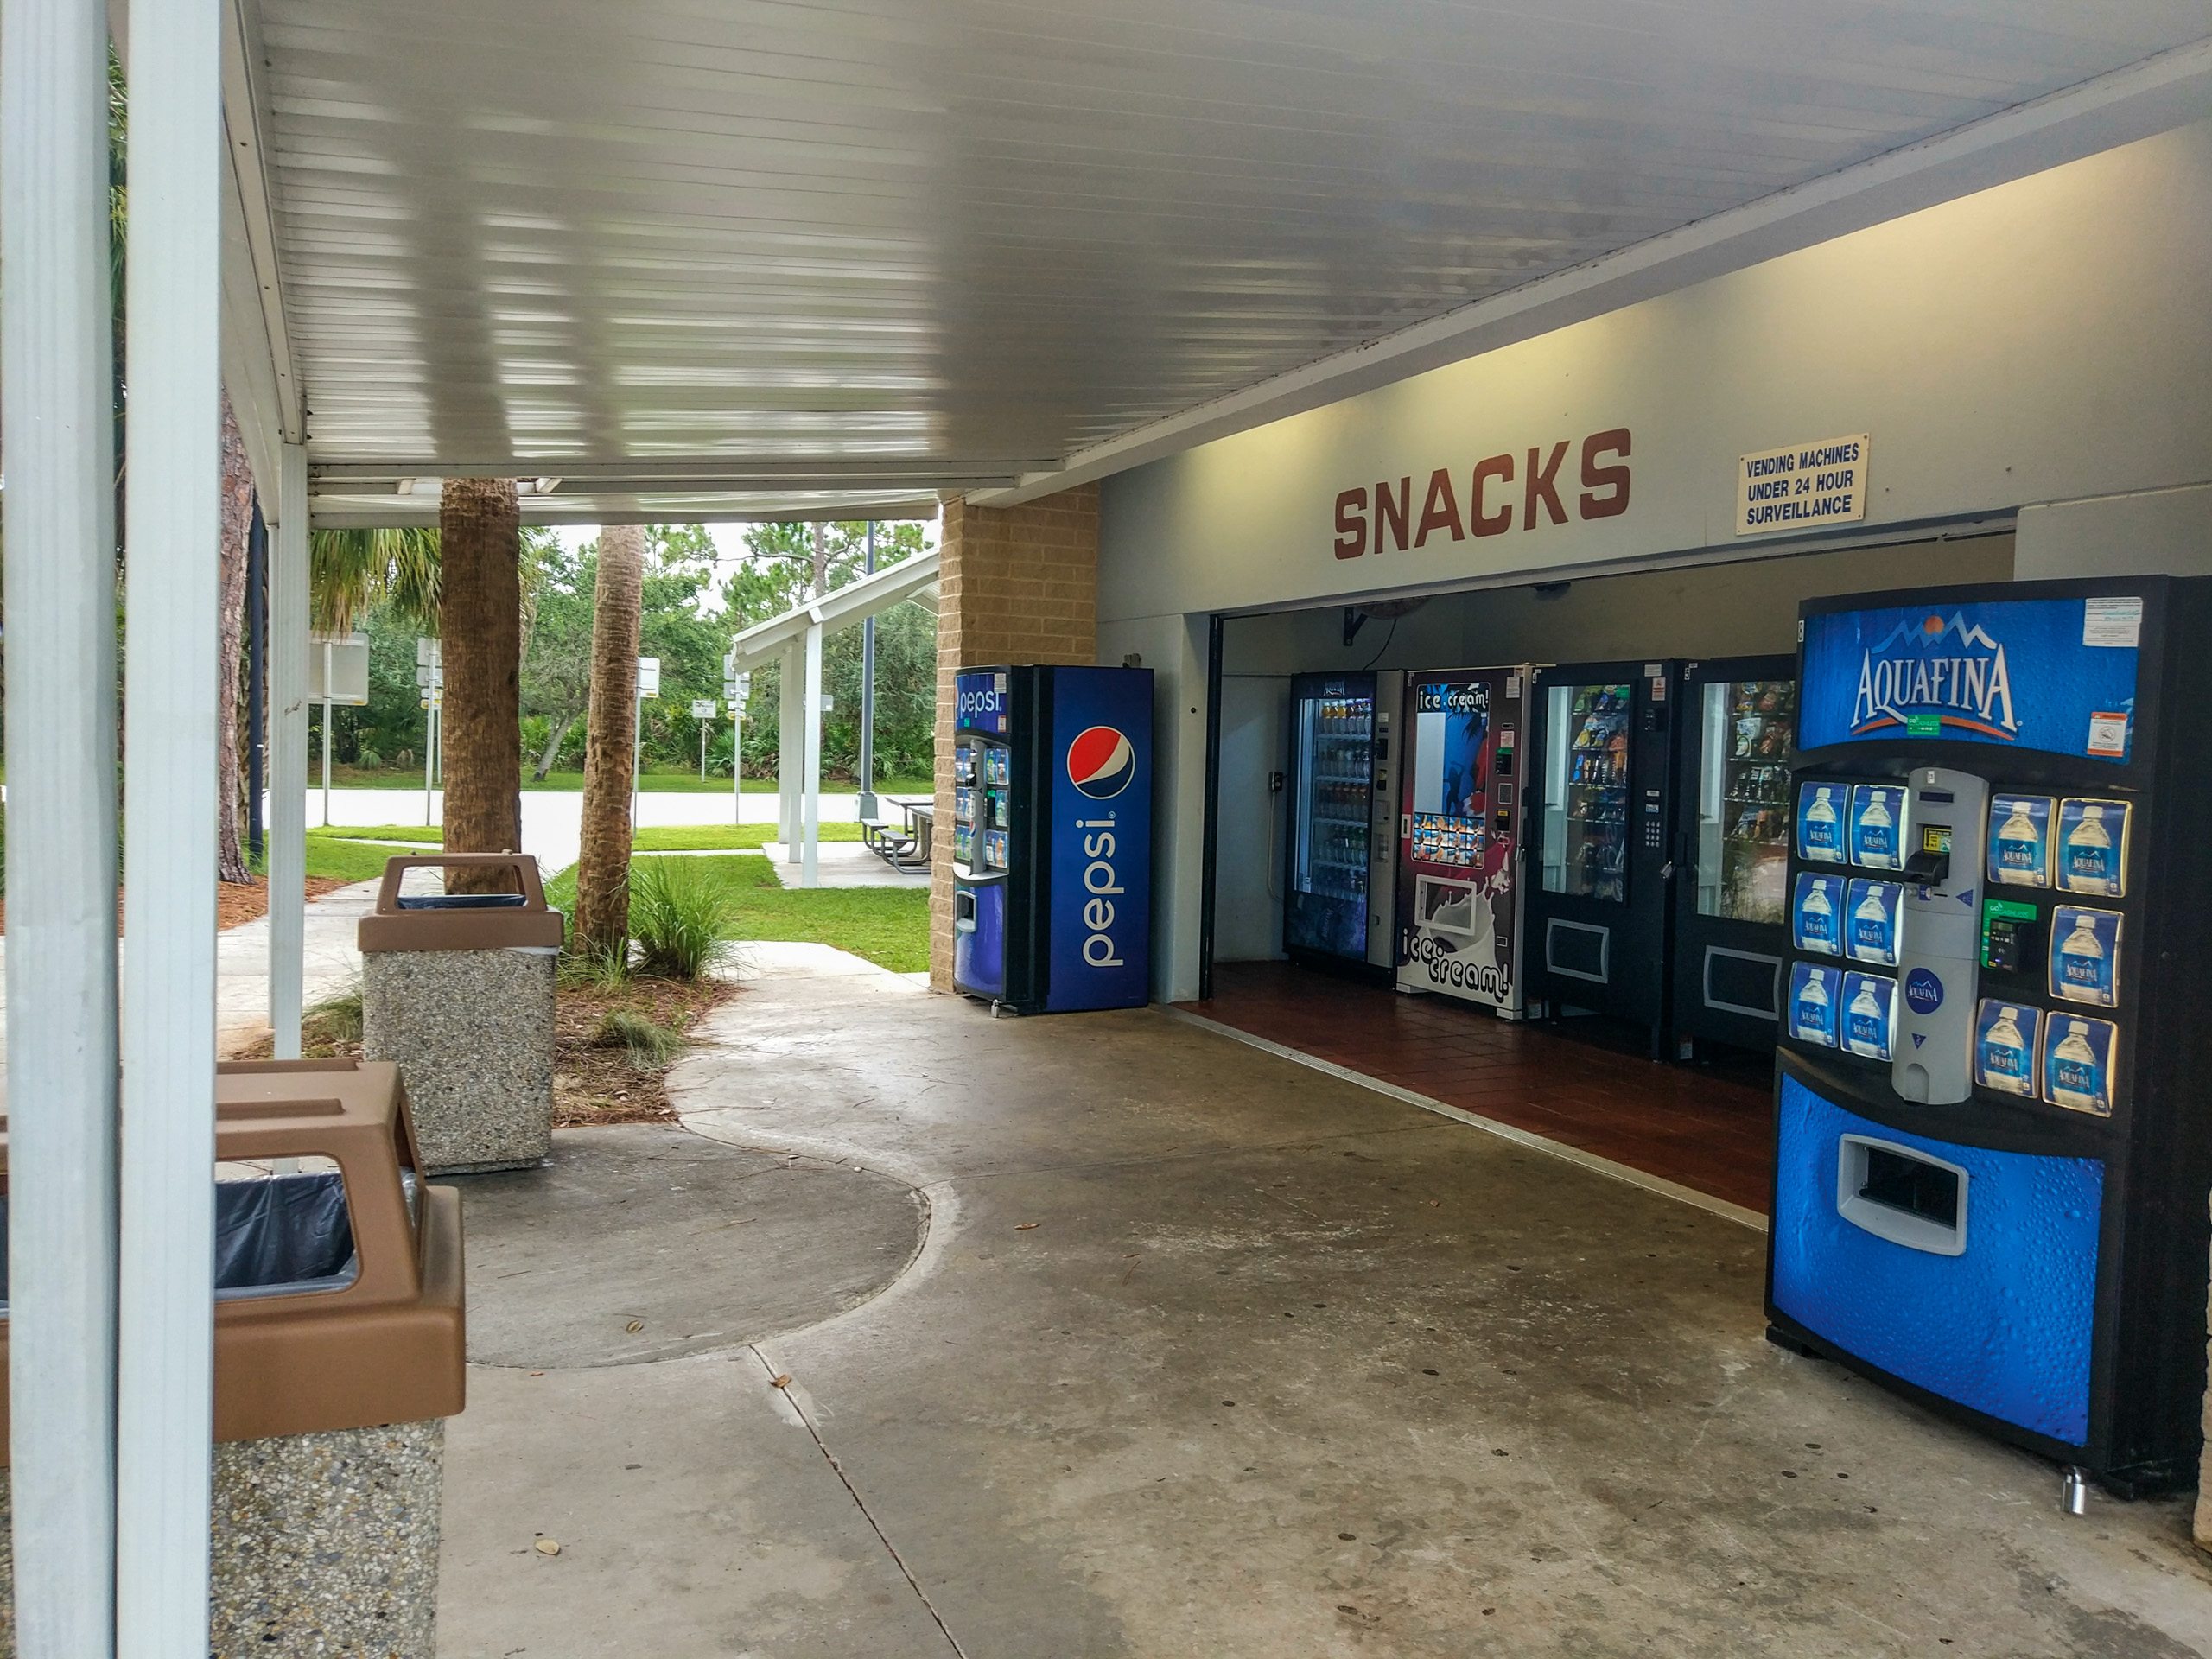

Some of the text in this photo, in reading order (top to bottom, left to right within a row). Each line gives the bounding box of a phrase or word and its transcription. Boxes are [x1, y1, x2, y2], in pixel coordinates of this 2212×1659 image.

[1747, 442, 1859, 477] VENDING MACHINES
[1334, 428, 1631, 560] SNACKS
[1748, 469, 1853, 501] UNDER 24 HOUR
[1746, 494, 1852, 524] SURVEILLANCE
[1420, 689, 1489, 709] ice cream!
[1850, 643, 2018, 733] AQUAFINA
[960, 690, 999, 719] pepsi
[2003, 849, 2033, 864] AQUAFINA
[2073, 855, 2105, 872] AQUAFINA
[1076, 820, 1125, 967] pepsi
[1403, 928, 1510, 1002] ice cream!
[2066, 964, 2098, 982] AQUAFINA
